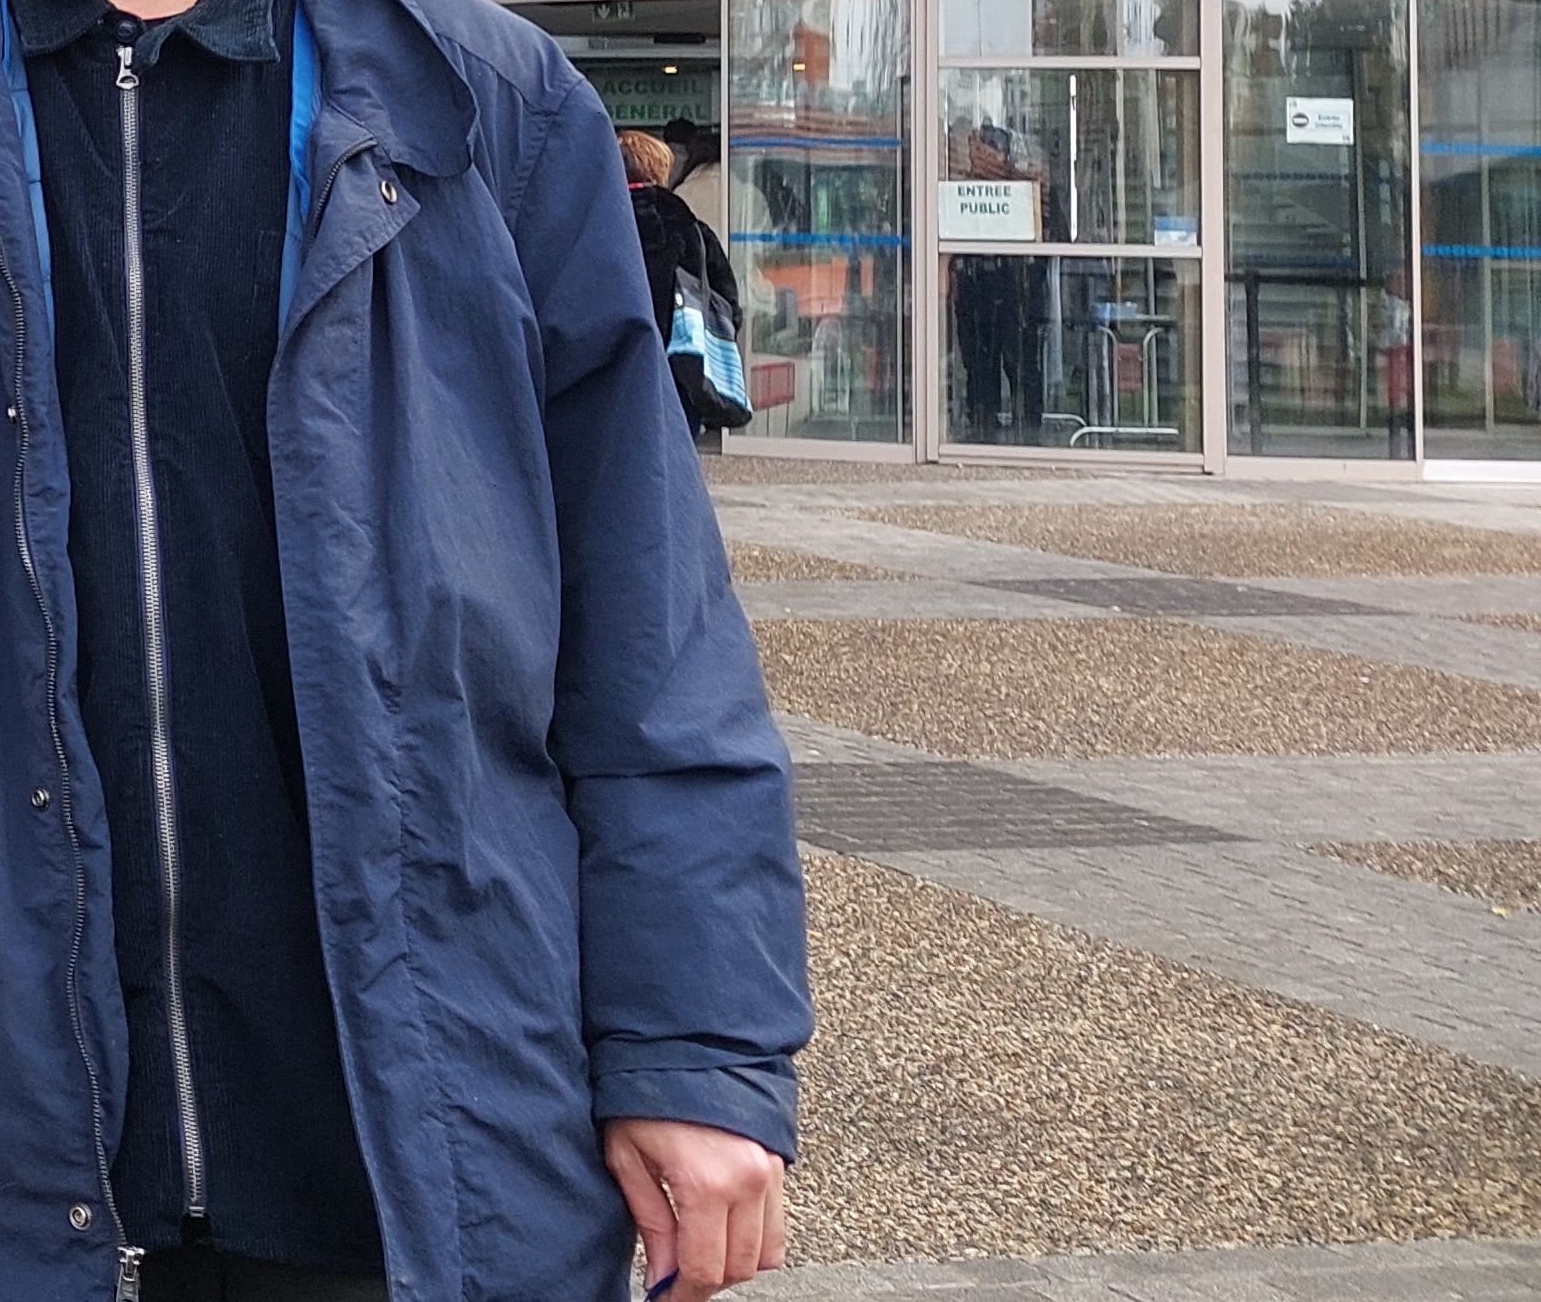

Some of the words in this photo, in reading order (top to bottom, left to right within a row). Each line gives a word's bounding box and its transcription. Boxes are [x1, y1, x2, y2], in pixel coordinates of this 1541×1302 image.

[602, 79, 704, 95] ACCUEIL
[957, 185, 1012, 197] ENTREE
[960, 202, 1010, 214] PUBLIC
